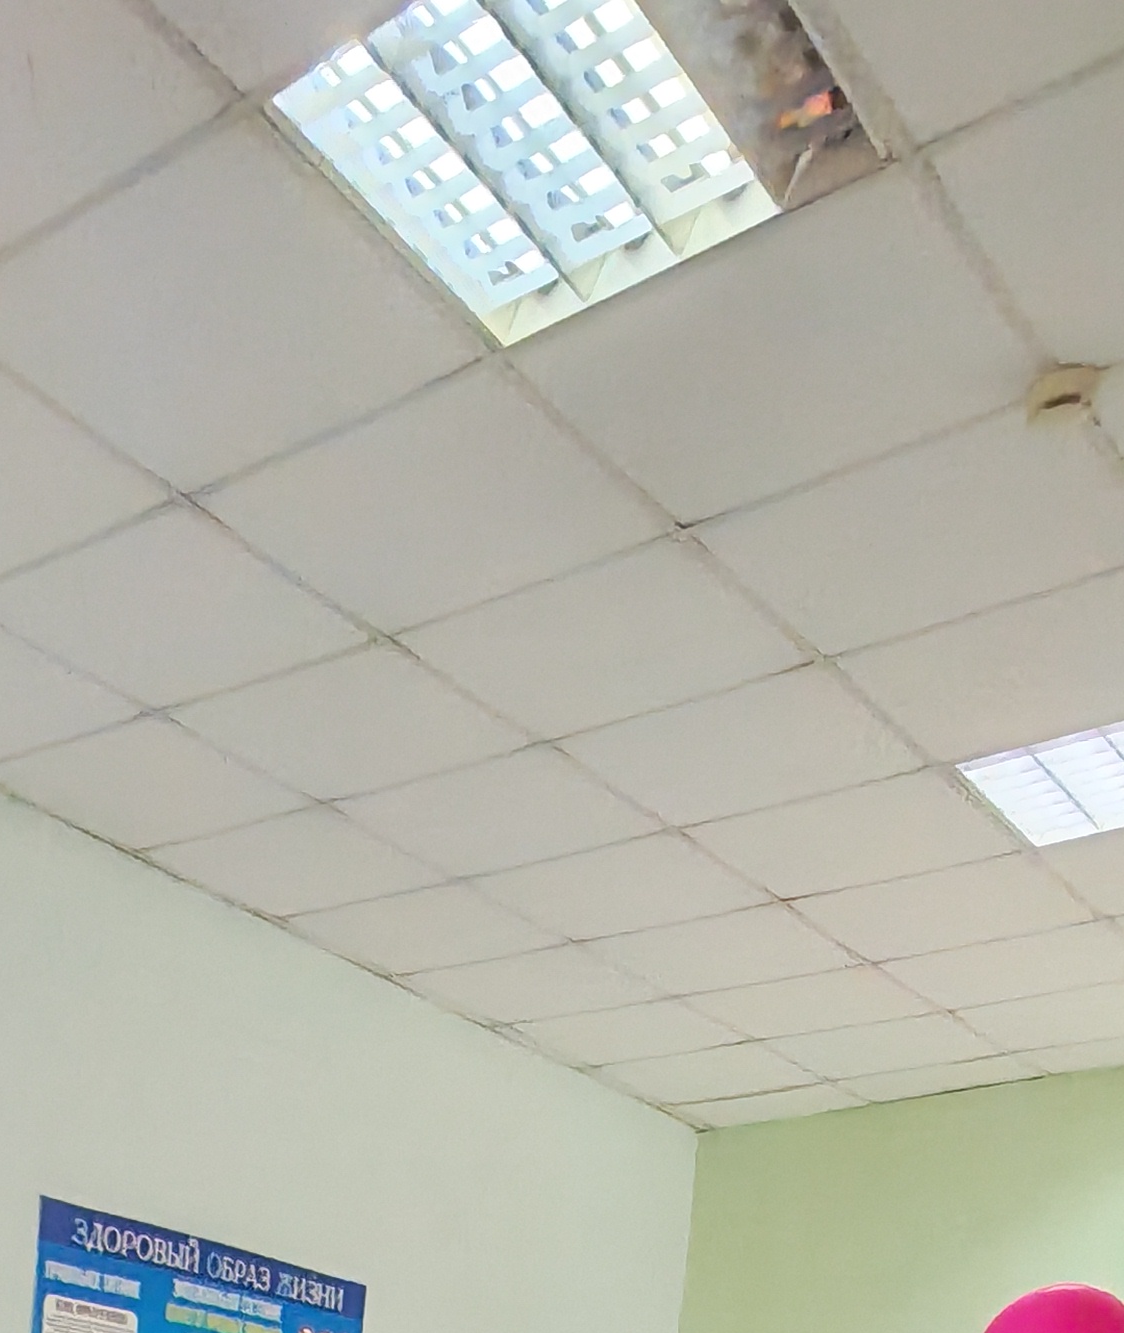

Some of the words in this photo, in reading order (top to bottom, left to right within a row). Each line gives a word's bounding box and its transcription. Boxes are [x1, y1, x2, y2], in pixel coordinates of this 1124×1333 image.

[71, 1217, 201, 1275] ЗДОРОВЫЙ
[206, 1251, 271, 1292] ОБРАЗ
[276, 1271, 344, 1313] ЖИЗНИ
